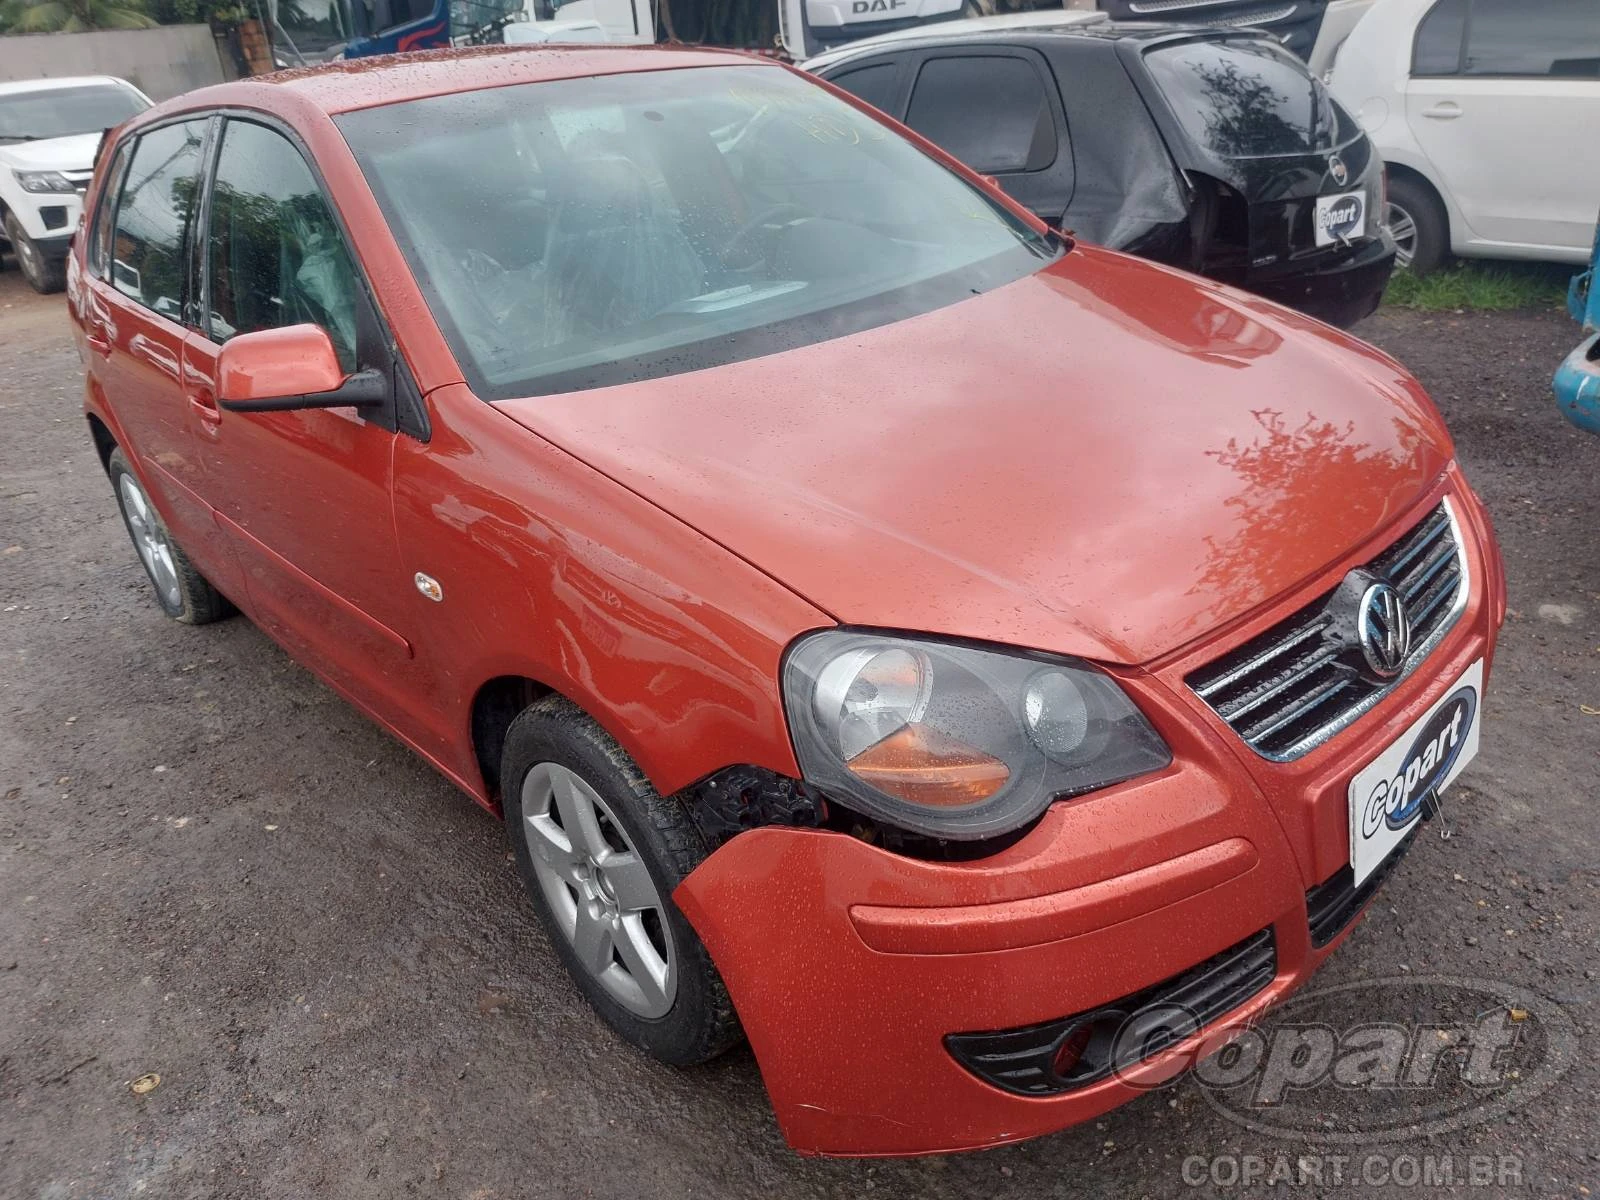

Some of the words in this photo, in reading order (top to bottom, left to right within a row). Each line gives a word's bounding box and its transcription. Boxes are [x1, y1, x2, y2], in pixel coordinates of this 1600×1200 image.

[852, 0, 906, 14] DAF
[1319, 203, 1356, 230] Copart
[1362, 703, 1462, 840] Copart
